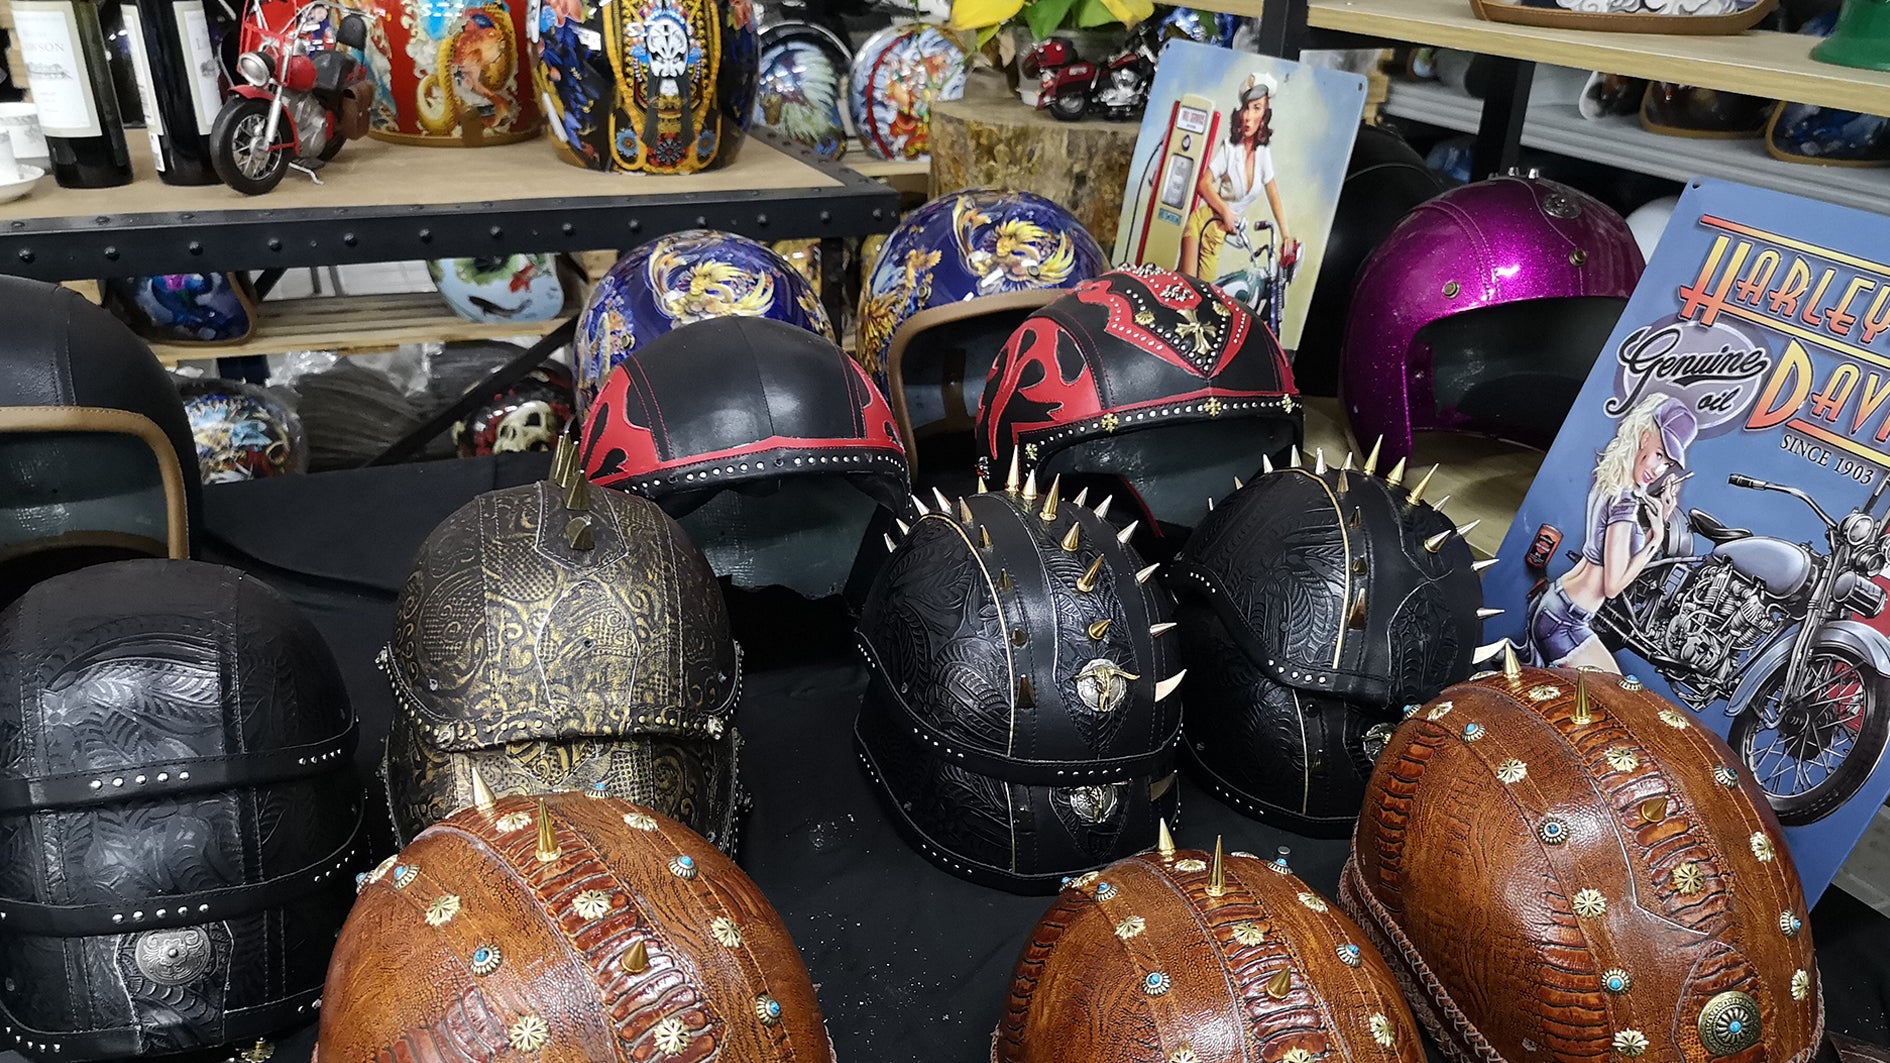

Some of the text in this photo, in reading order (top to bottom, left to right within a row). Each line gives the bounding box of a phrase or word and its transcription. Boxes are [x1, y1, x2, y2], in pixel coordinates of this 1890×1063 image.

[1605, 328, 1770, 415] Genuine
[1697, 386, 1740, 411] oil
[1780, 434, 1874, 485] SINCE 1903
